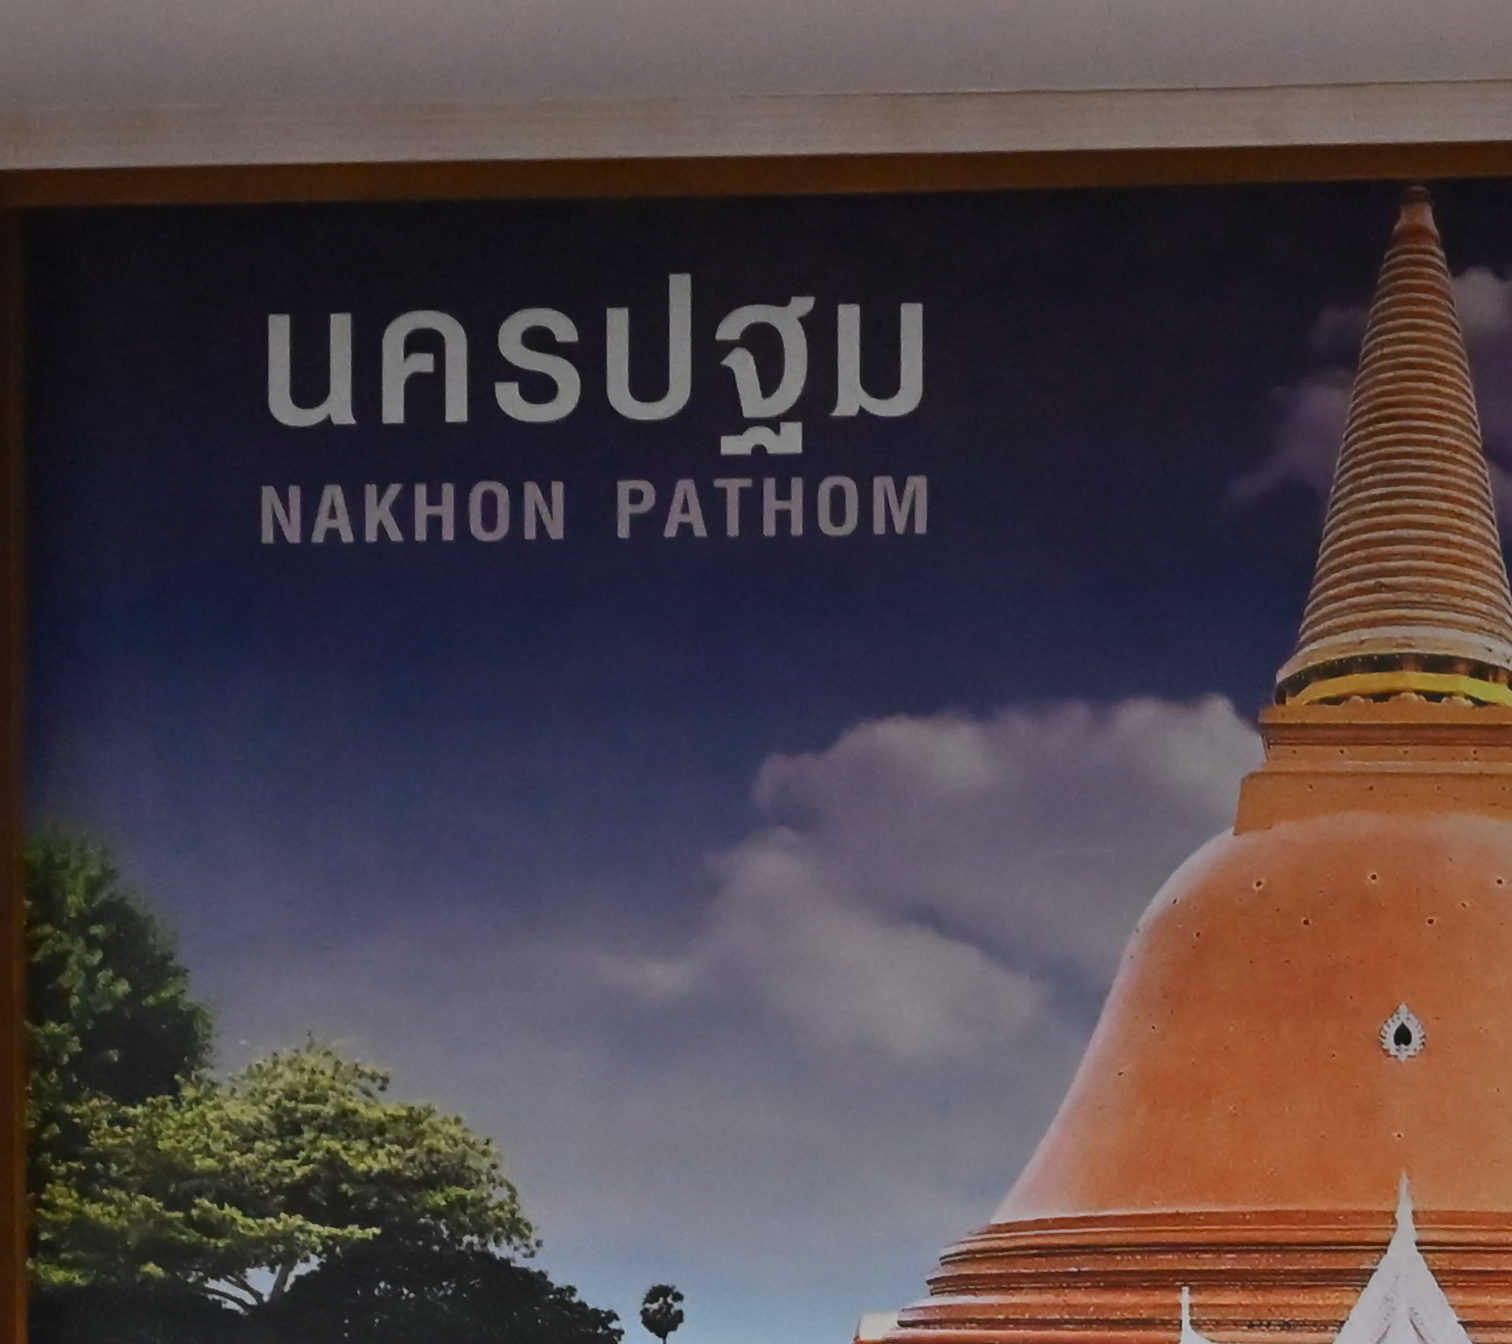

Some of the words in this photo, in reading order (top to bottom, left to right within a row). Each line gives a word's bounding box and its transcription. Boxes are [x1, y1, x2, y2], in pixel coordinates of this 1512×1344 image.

[266, 272, 925, 456] นครปฐม
[261, 480, 566, 545] NAKHON
[615, 474, 929, 540] PATHOM
